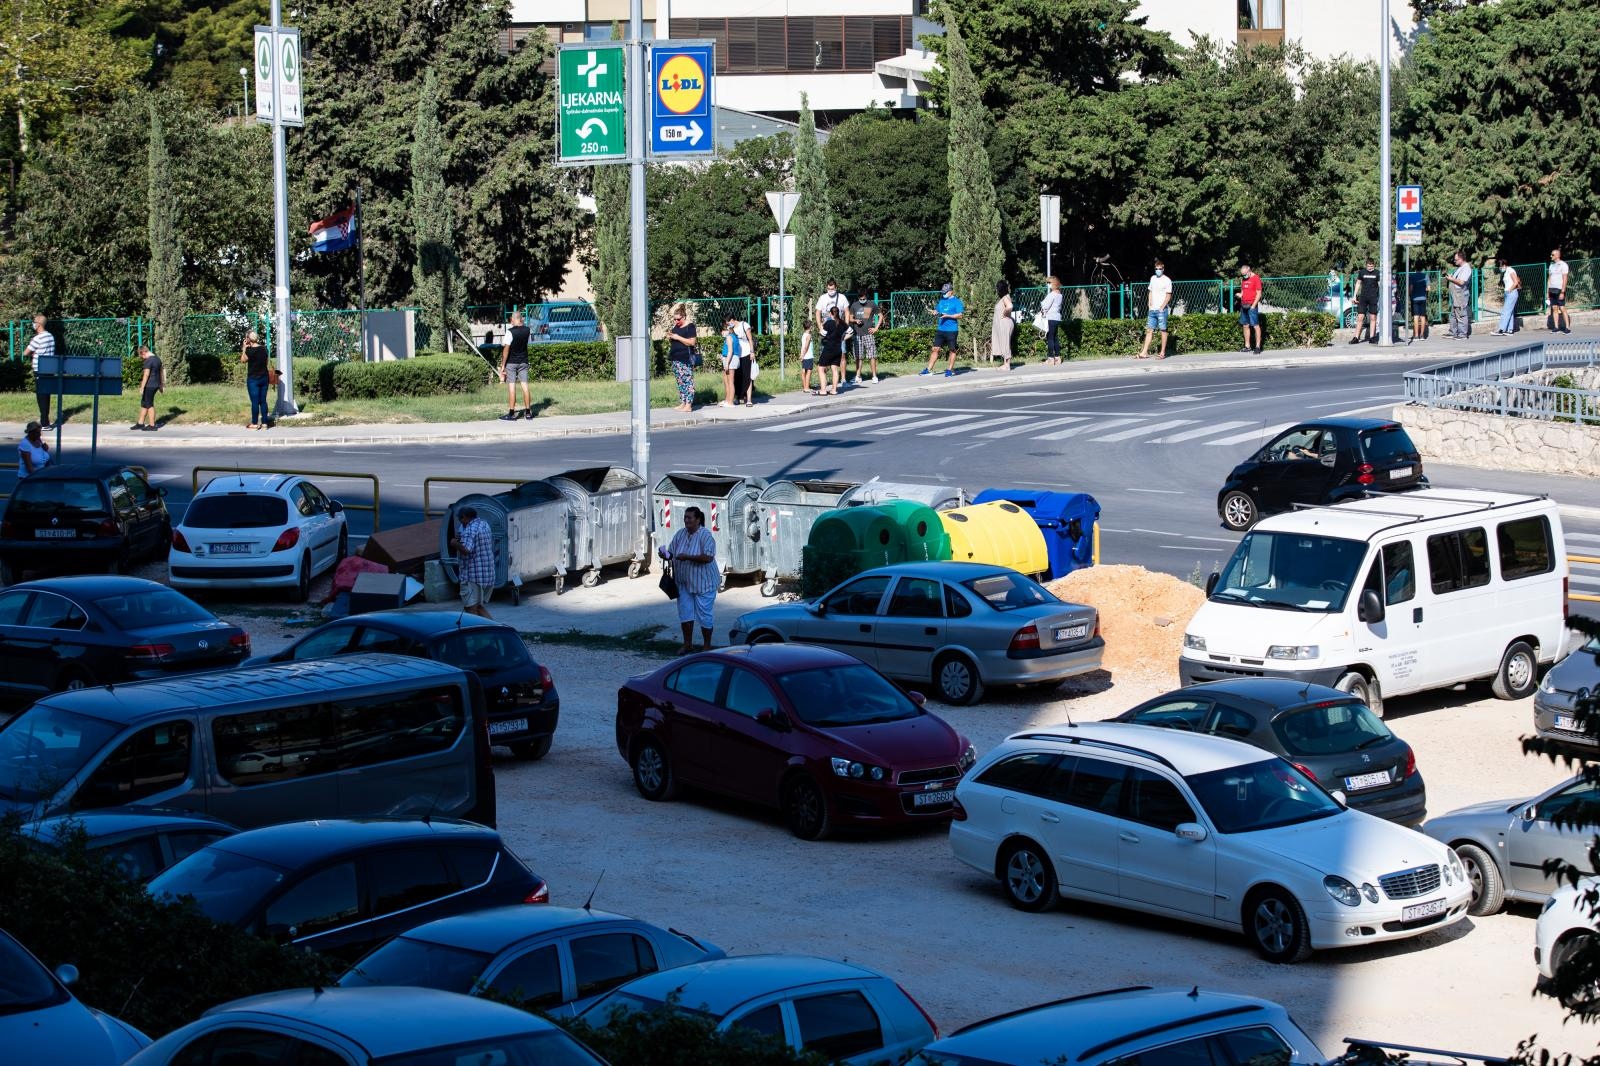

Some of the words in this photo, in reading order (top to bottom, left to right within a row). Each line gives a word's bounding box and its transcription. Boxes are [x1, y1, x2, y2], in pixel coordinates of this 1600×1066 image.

[562, 91, 622, 108] LJEKARNA
[665, 129, 675, 138] 150
[581, 142, 598, 153] 250
[1409, 907, 1416, 918] ST
